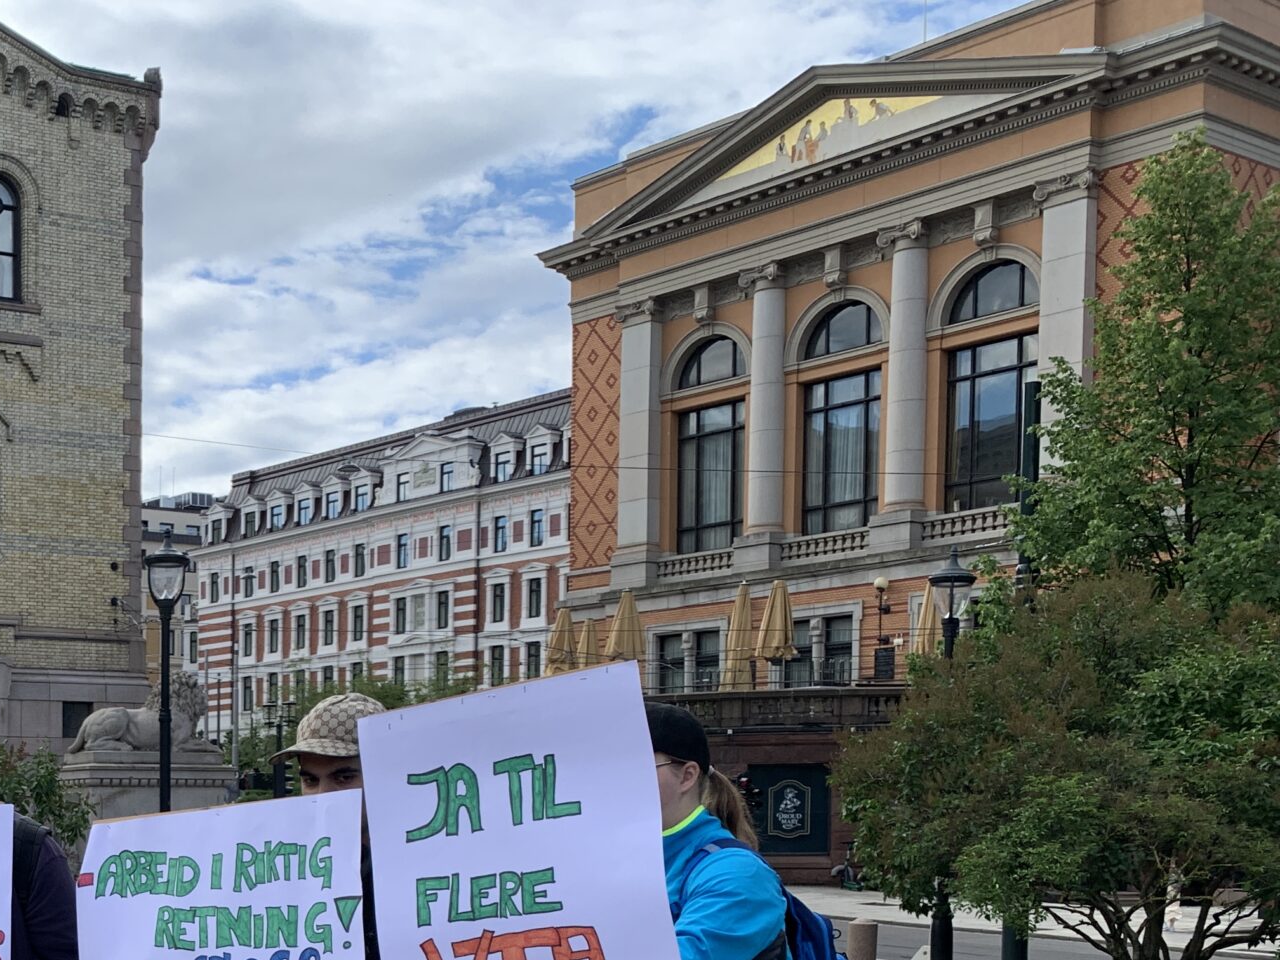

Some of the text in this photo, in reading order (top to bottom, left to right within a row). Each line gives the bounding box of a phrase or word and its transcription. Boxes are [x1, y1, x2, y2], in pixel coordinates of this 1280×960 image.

[405, 753, 582, 843] JA TIL
[210, 853, 223, 890] I
[232, 836, 333, 892] RIKTIG
[415, 866, 563, 928] FLERE
